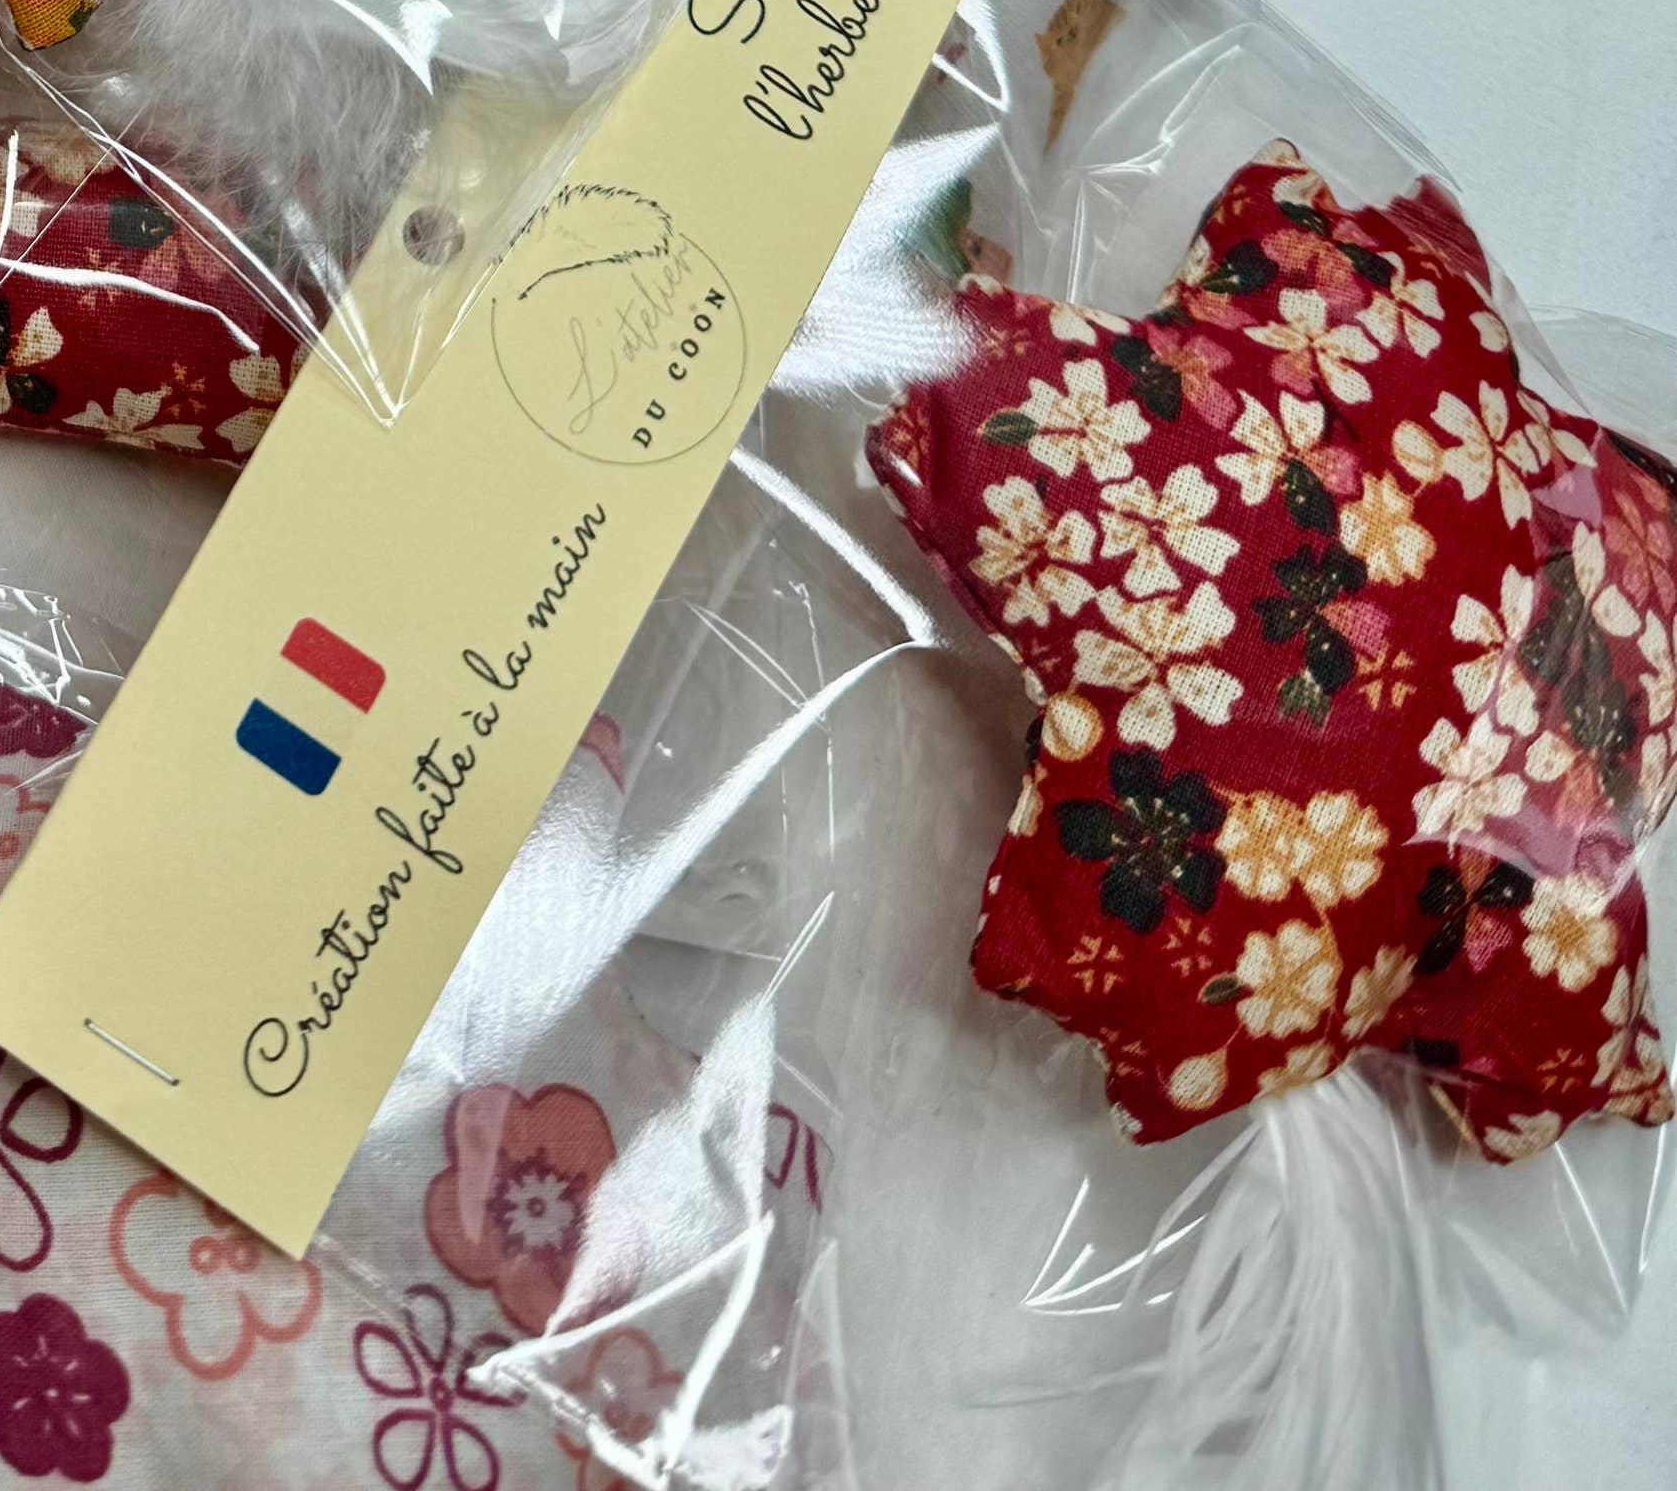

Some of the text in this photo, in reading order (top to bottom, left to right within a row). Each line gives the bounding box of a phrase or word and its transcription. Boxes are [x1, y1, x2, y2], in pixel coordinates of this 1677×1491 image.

[631, 399, 667, 449] DU
[242, 501, 608, 1099] Création faite à la main
